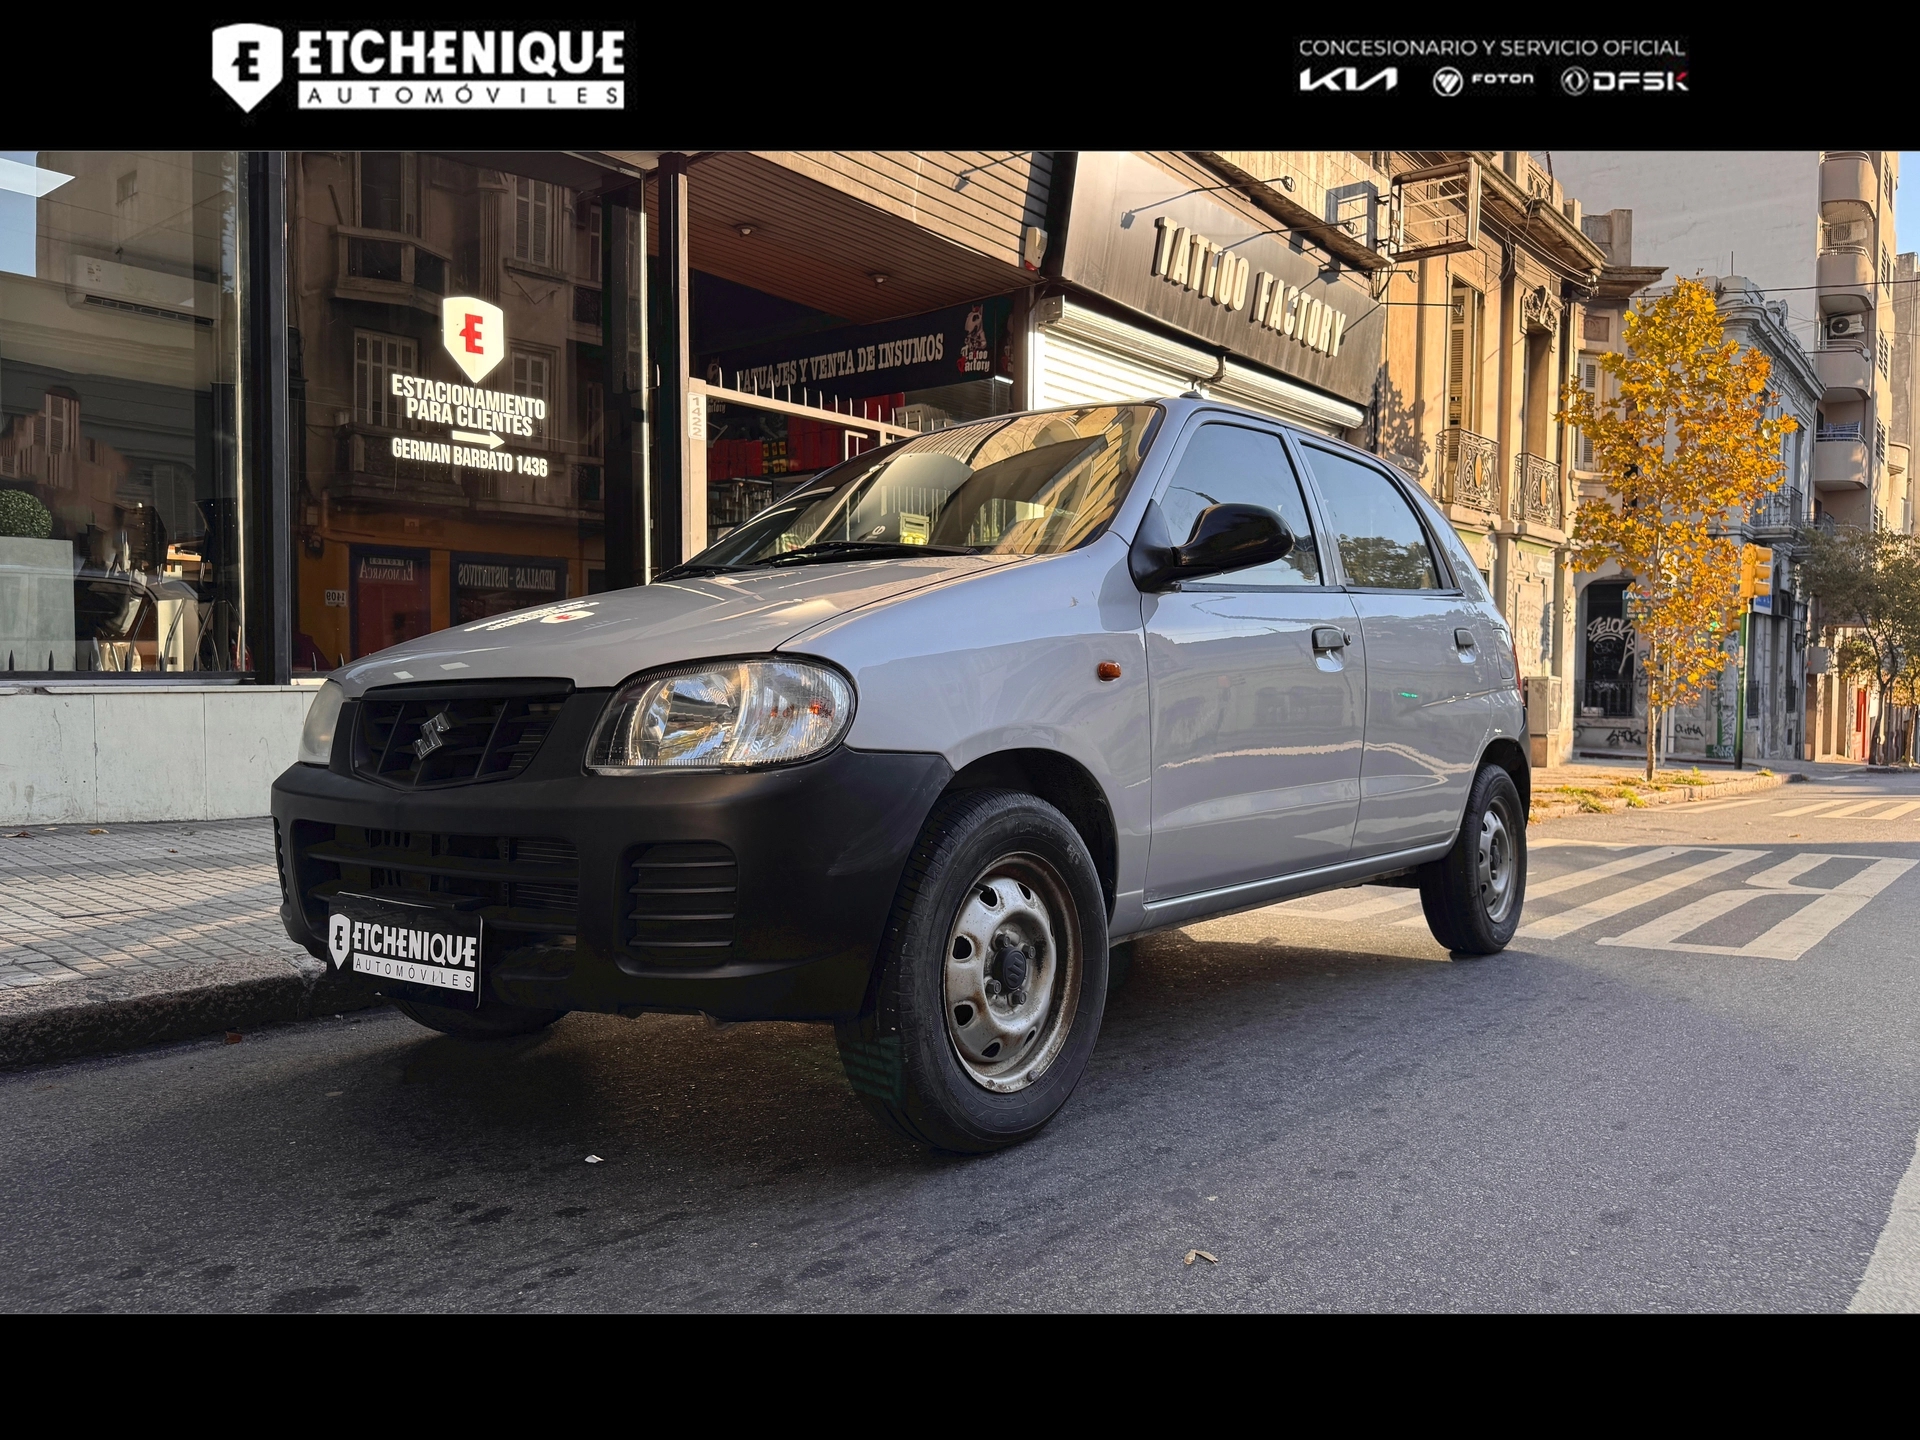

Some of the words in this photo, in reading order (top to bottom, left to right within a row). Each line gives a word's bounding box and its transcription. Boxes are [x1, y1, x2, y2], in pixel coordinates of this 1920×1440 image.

[1153, 216, 1249, 311] TATTOO
[1254, 271, 1346, 358] FACTORY
[799, 358, 809, 383] Y
[810, 349, 855, 381] VENTA
[857, 345, 876, 373] DE
[878, 333, 944, 370] INSUMOS
[392, 373, 546, 420] ESTACIONAMIENTO
[406, 397, 454, 425] PARA
[457, 408, 533, 437] CLIENTES
[691, 396, 703, 437] 1422
[392, 437, 450, 464] GERMAN
[453, 447, 513, 473] BARBATO
[516, 455, 548, 478] 1436
[352, 921, 477, 967] ETCHENIQUE
[355, 957, 472, 988] AUTOMÓVILES
